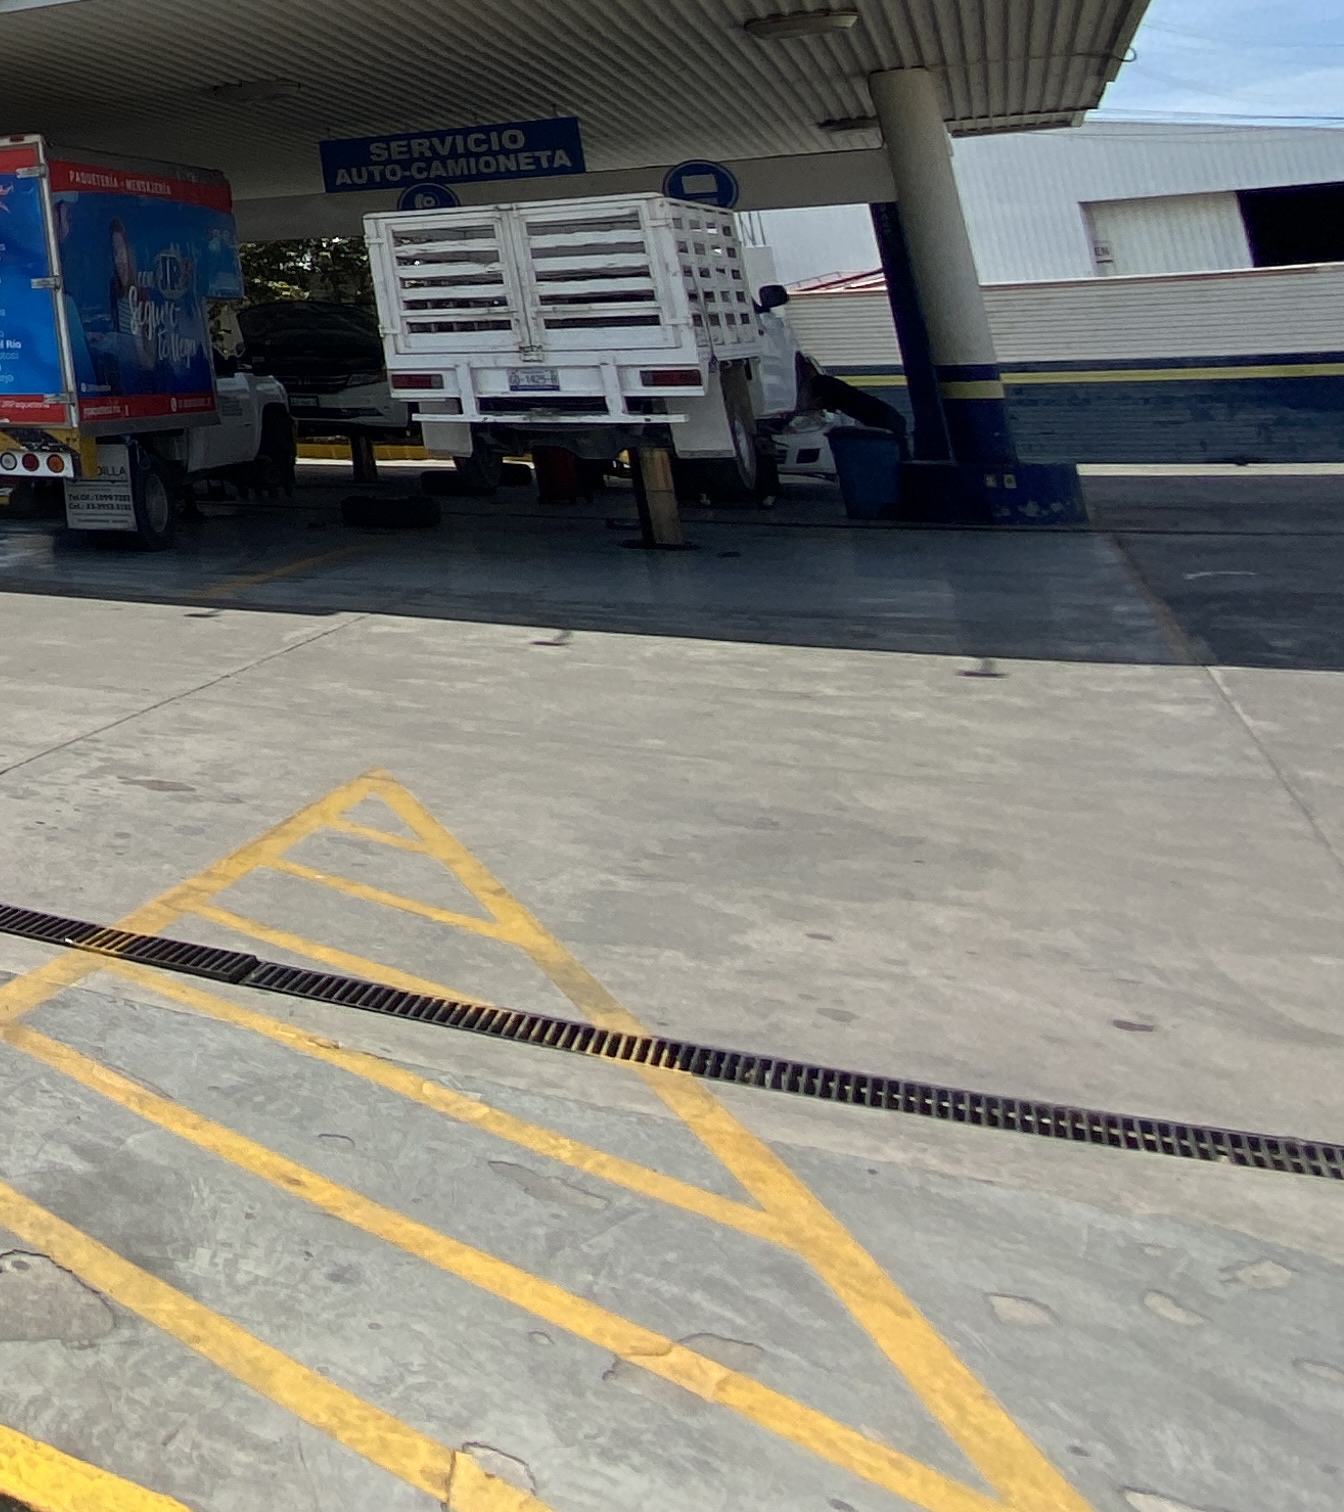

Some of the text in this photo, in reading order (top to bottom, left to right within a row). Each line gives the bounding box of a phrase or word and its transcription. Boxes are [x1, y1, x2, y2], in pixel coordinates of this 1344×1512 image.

[369, 129, 525, 163] SERVICIO
[335, 149, 573, 187] AUTO-CAMIONETA
[6, 339, 21, 348] Río
